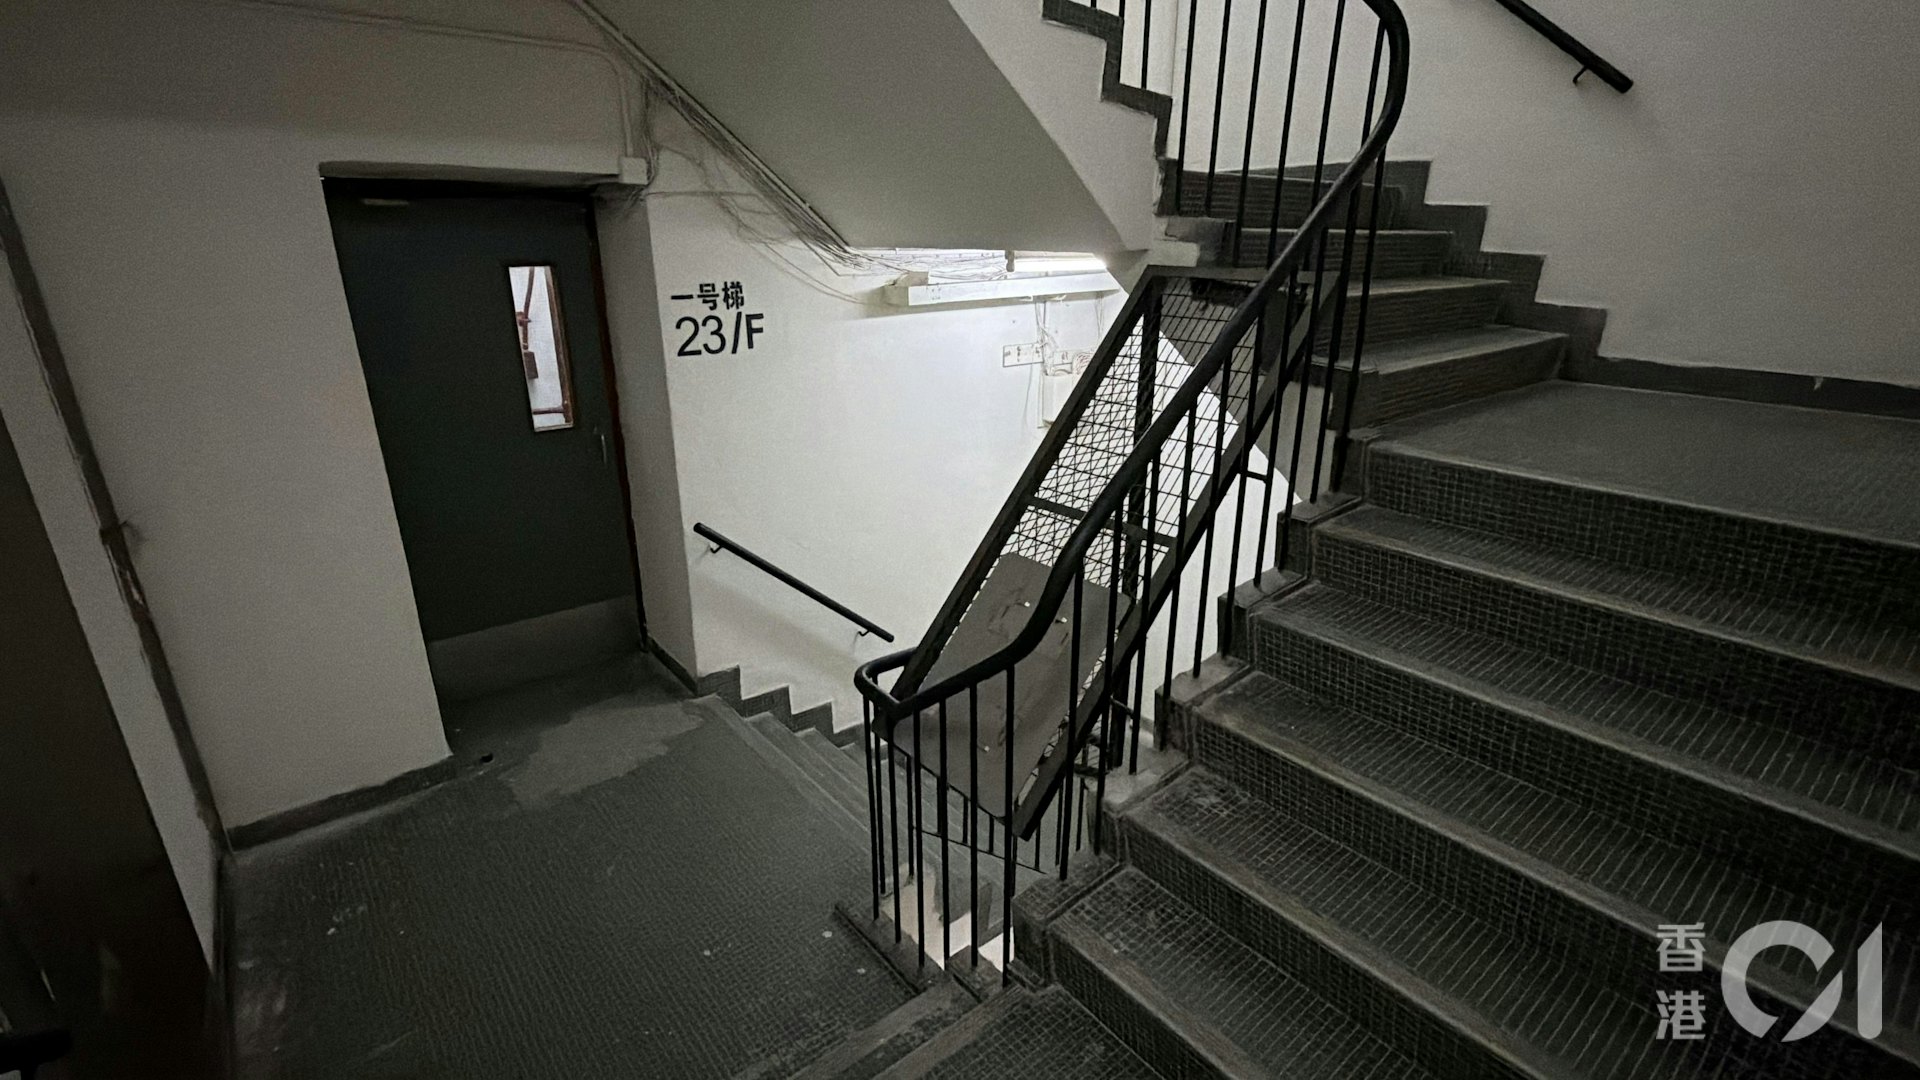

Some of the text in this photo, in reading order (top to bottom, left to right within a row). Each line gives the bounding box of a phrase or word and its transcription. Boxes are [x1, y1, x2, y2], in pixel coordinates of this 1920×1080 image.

[671, 281, 744, 311] 一号梯
[675, 311, 764, 357] 23/F
